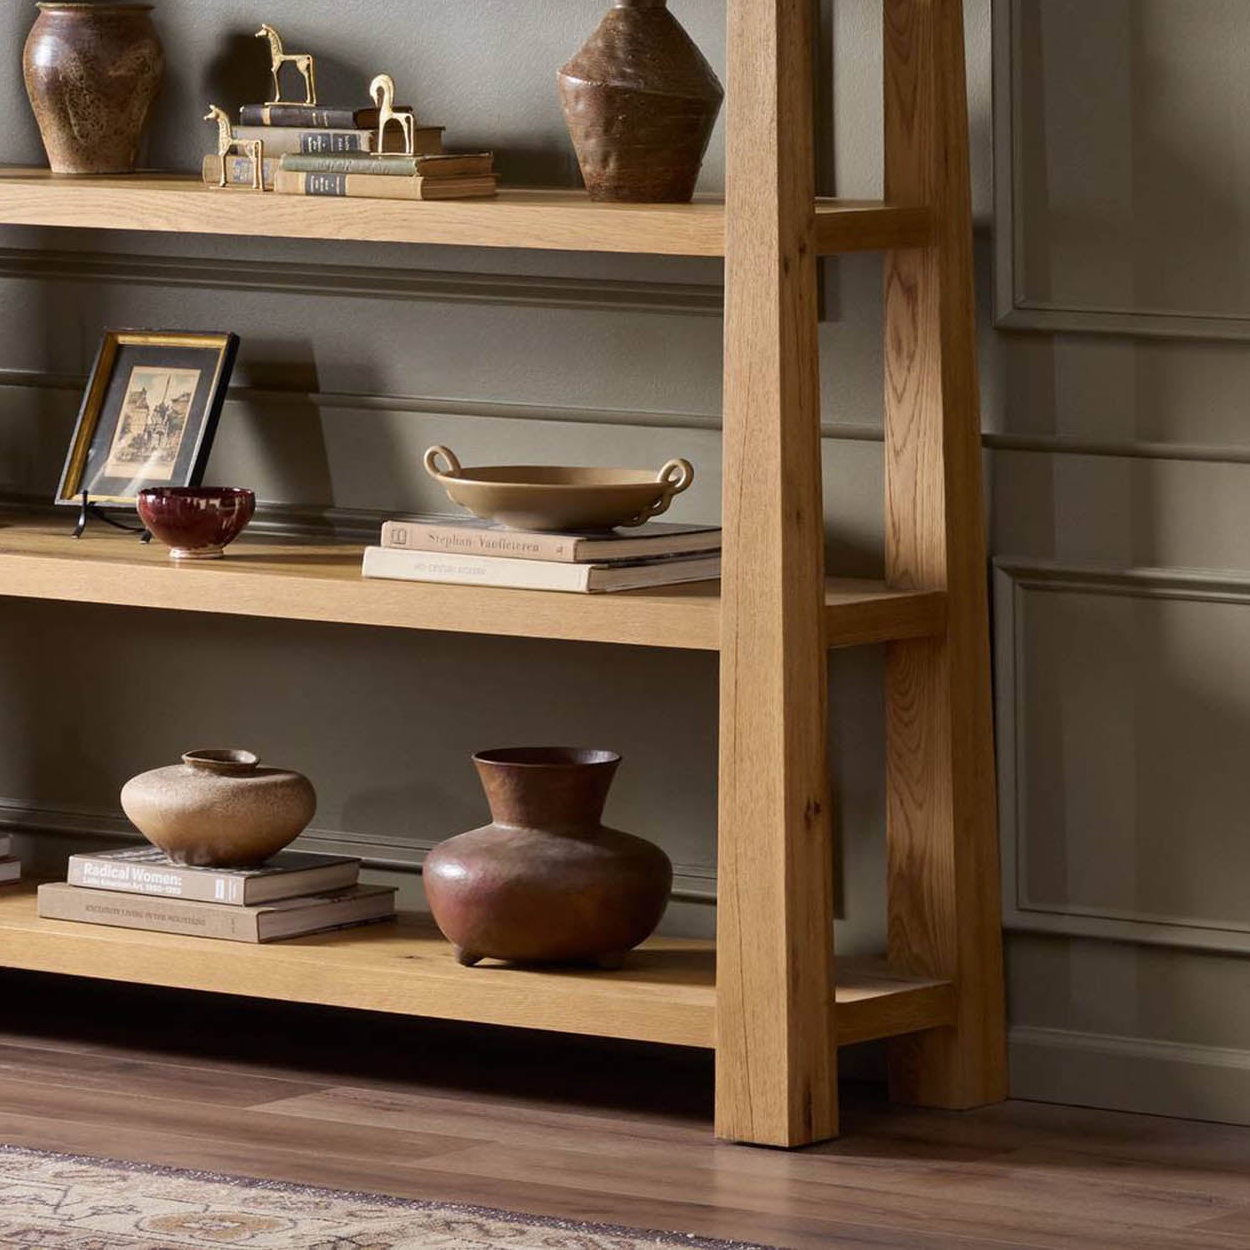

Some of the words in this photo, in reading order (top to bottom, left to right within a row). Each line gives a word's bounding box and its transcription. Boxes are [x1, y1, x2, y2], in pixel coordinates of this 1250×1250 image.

[428, 533, 472, 547] Stephan
[84, 862, 130, 879] Radical
[131, 868, 183, 886] Women:
